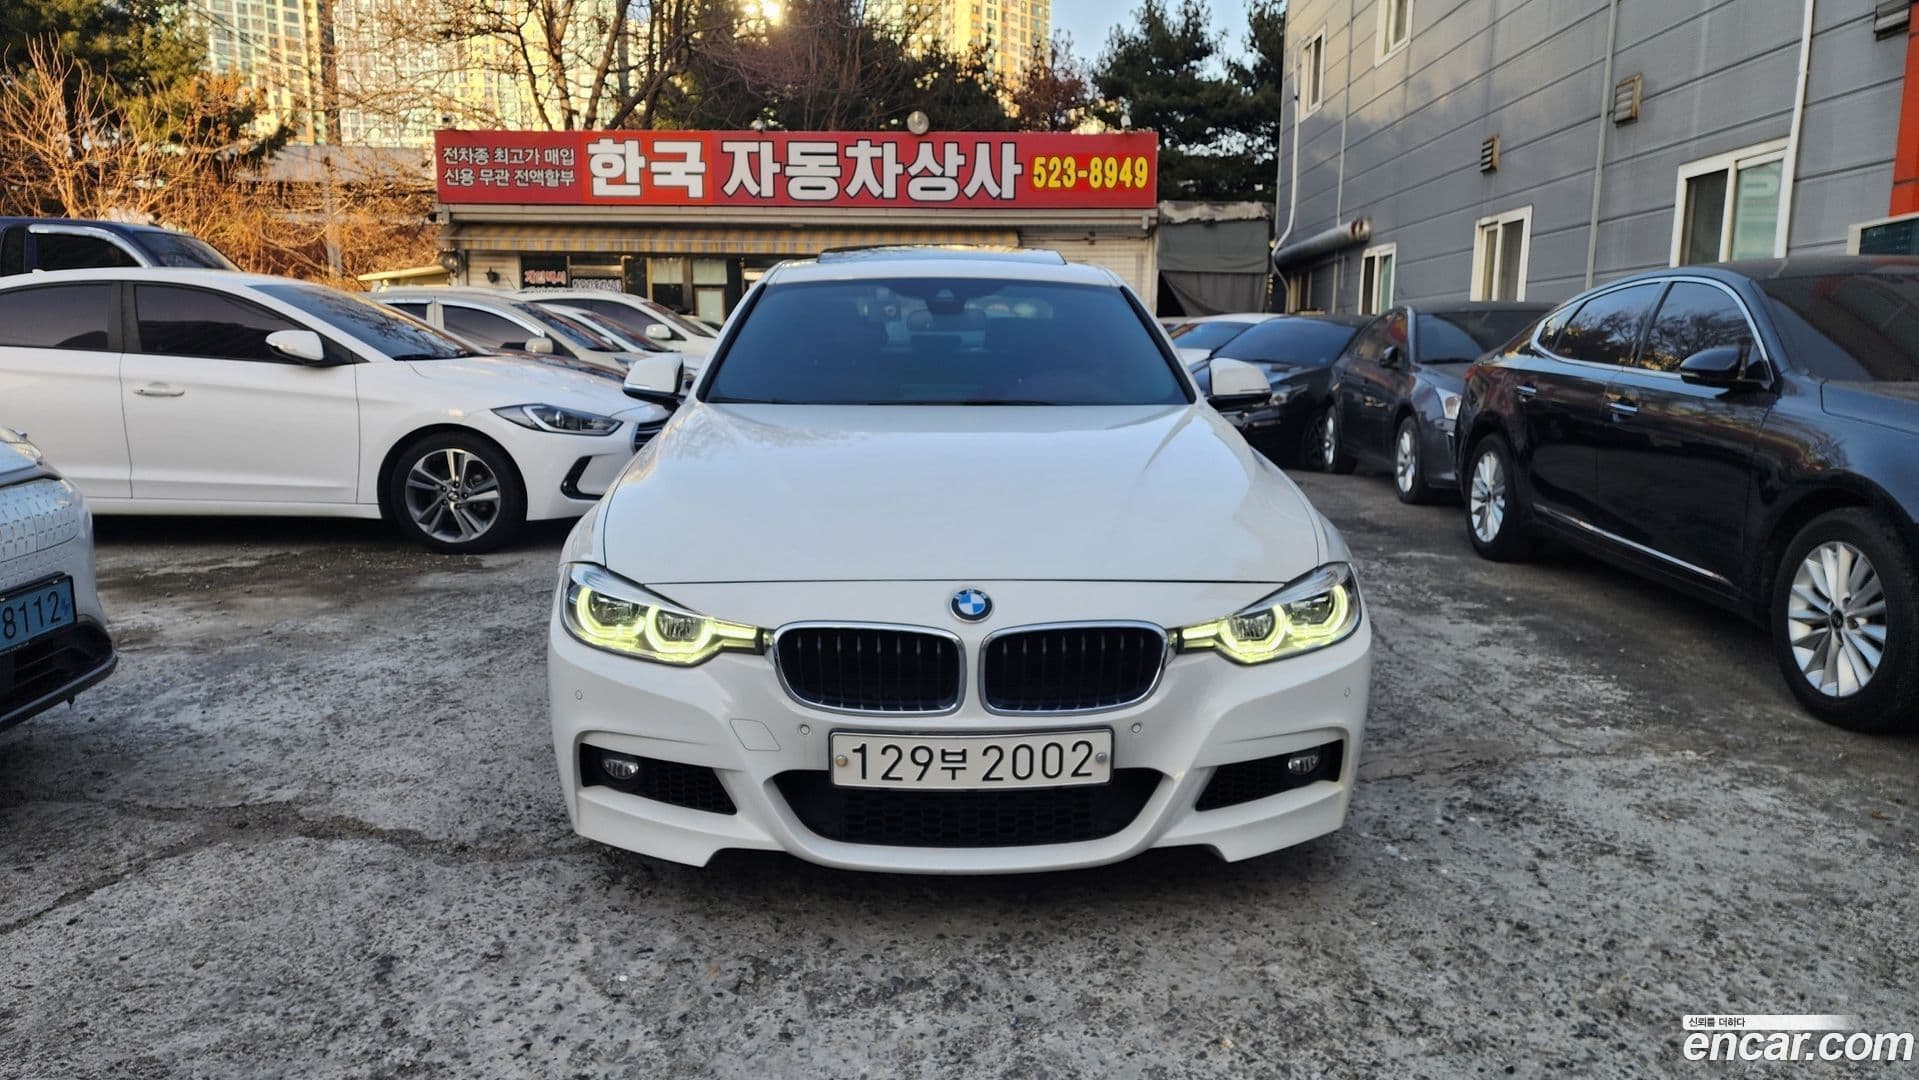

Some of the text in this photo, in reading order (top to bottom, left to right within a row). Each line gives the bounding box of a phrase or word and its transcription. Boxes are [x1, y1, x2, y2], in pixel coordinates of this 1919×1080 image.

[443, 147, 575, 166] 전차종 최고가 매입
[444, 168, 576, 187] 신용 무관 전액할부
[587, 138, 1149, 201] 한국 자동차상사 523-8949
[2, 591, 62, 639] 8112
[852, 740, 1094, 782] 129부 2002
